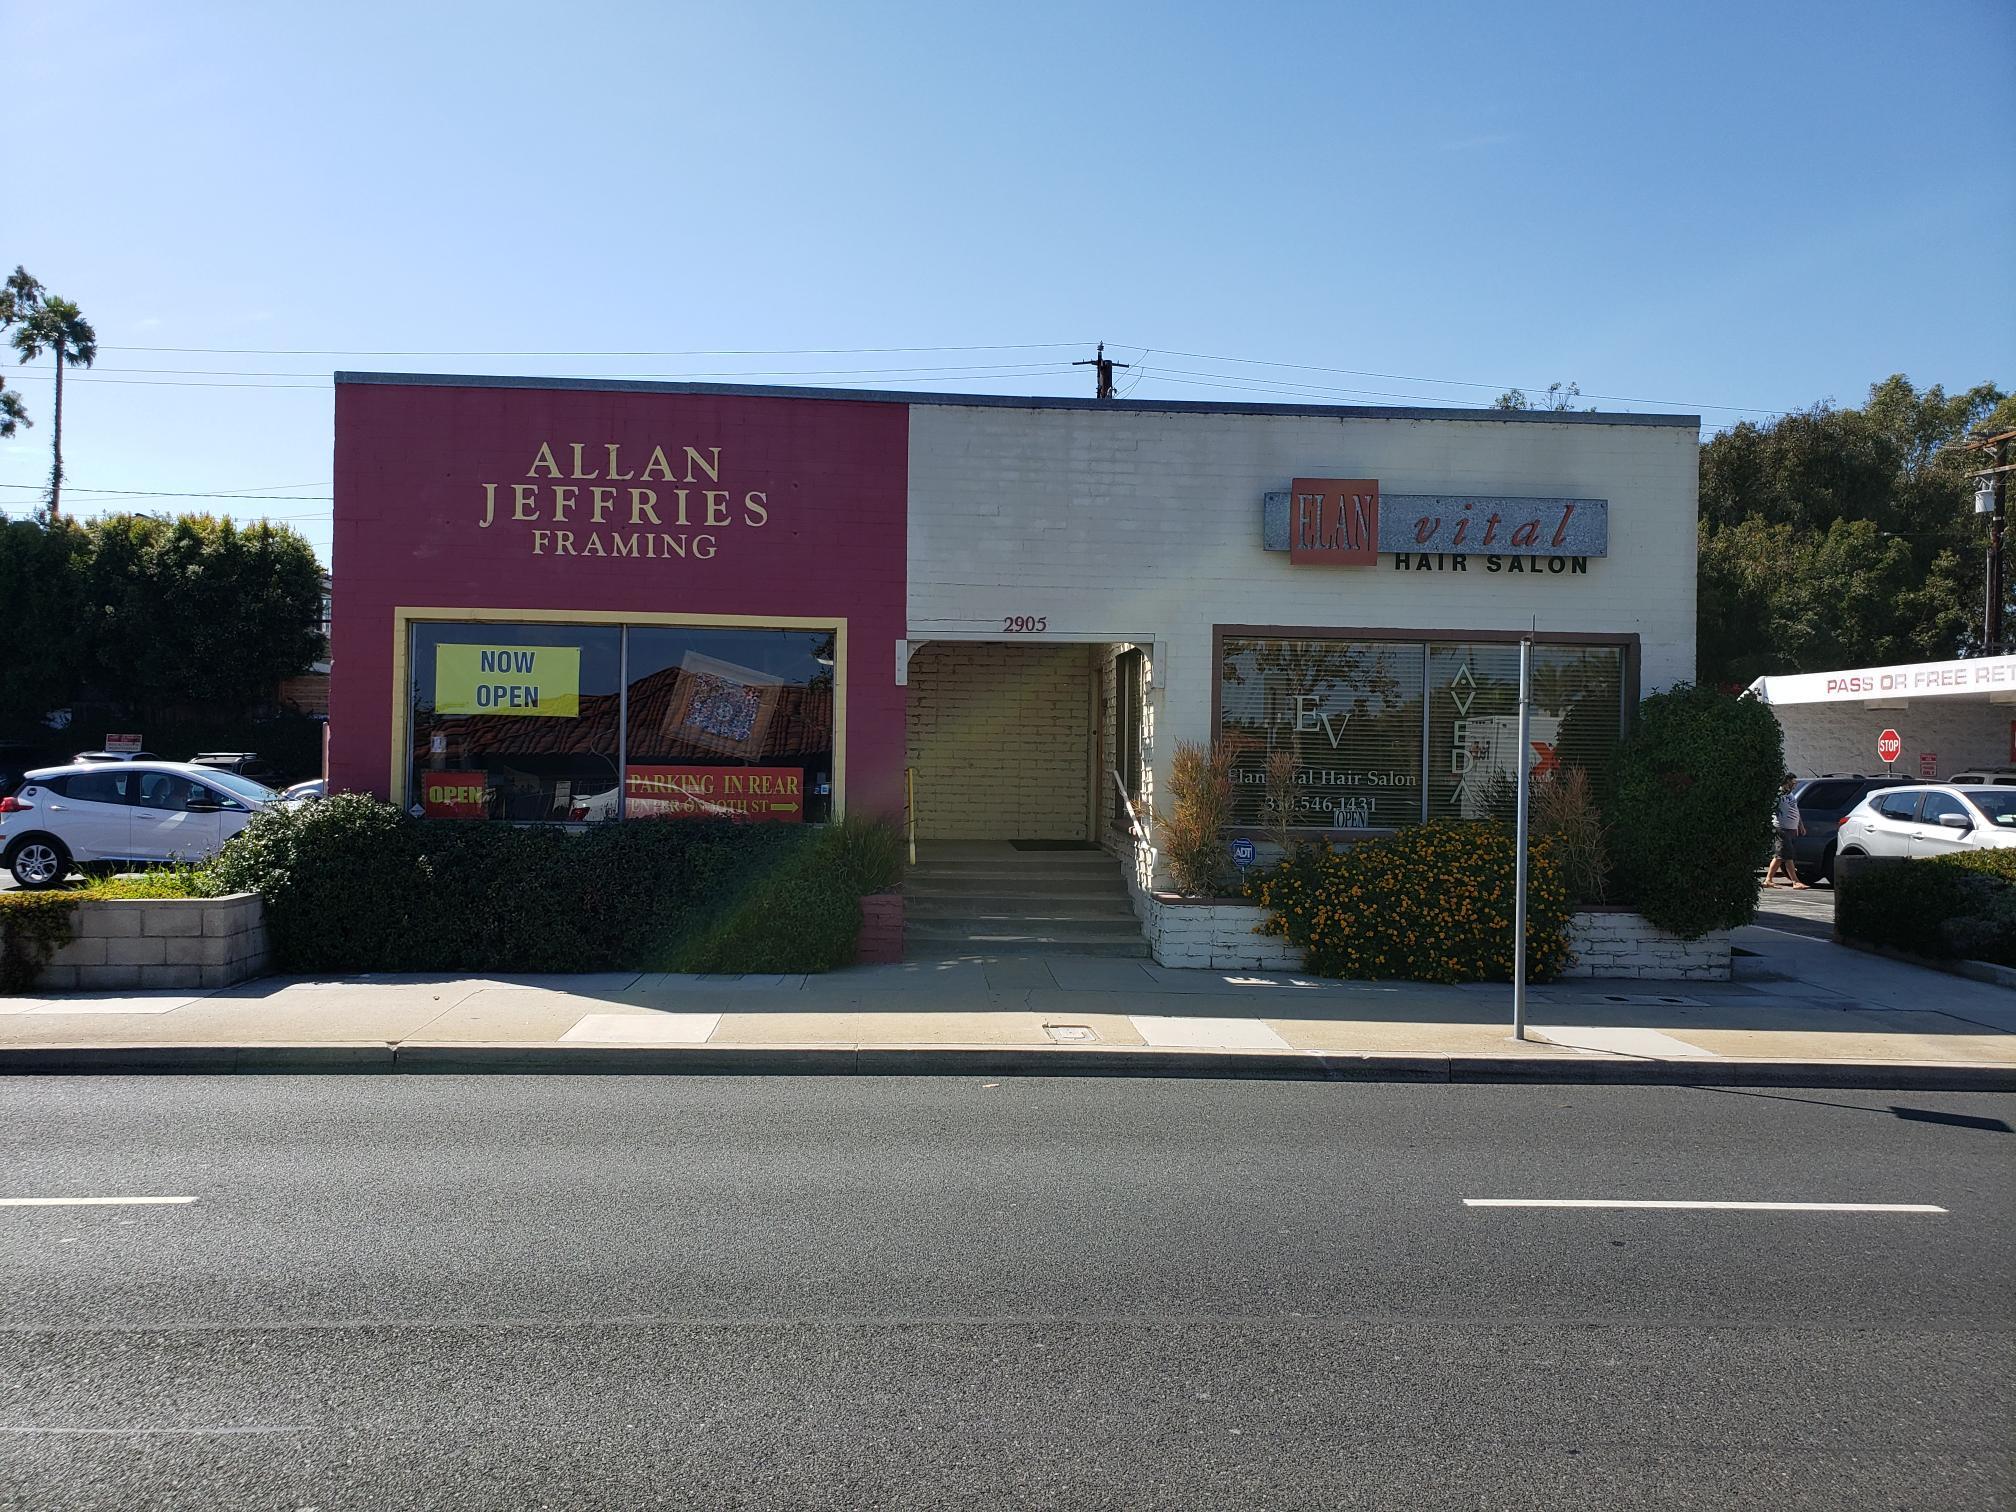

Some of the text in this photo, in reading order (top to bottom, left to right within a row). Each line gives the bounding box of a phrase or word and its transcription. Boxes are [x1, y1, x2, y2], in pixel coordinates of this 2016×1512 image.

[525, 441, 722, 483] ALLAN
[479, 483, 768, 528] JEFFRIES
[1297, 493, 1575, 551] ELAN vital
[532, 530, 718, 559] FRAMING
[1395, 554, 1588, 574] HAIR SALON
[1003, 616, 1047, 632] 2905
[481, 650, 536, 674] NOW
[1827, 676, 1874, 694] PASS
[1880, 673, 1907, 690] OR
[1914, 668, 1968, 688] FREE
[476, 684, 539, 708] OPEN
[1450, 662, 1478, 804] AVEDA
[1879, 739, 1899, 752] STOP
[630, 774, 800, 795] PARKING IN REAR
[1321, 769, 1362, 785] Hair
[1367, 770, 1417, 786] Salon
[429, 786, 483, 803] OPEN
[752, 800, 768, 813] ST
[1336, 810, 1366, 828] OPEN
[1235, 847, 1251, 858] ADT
